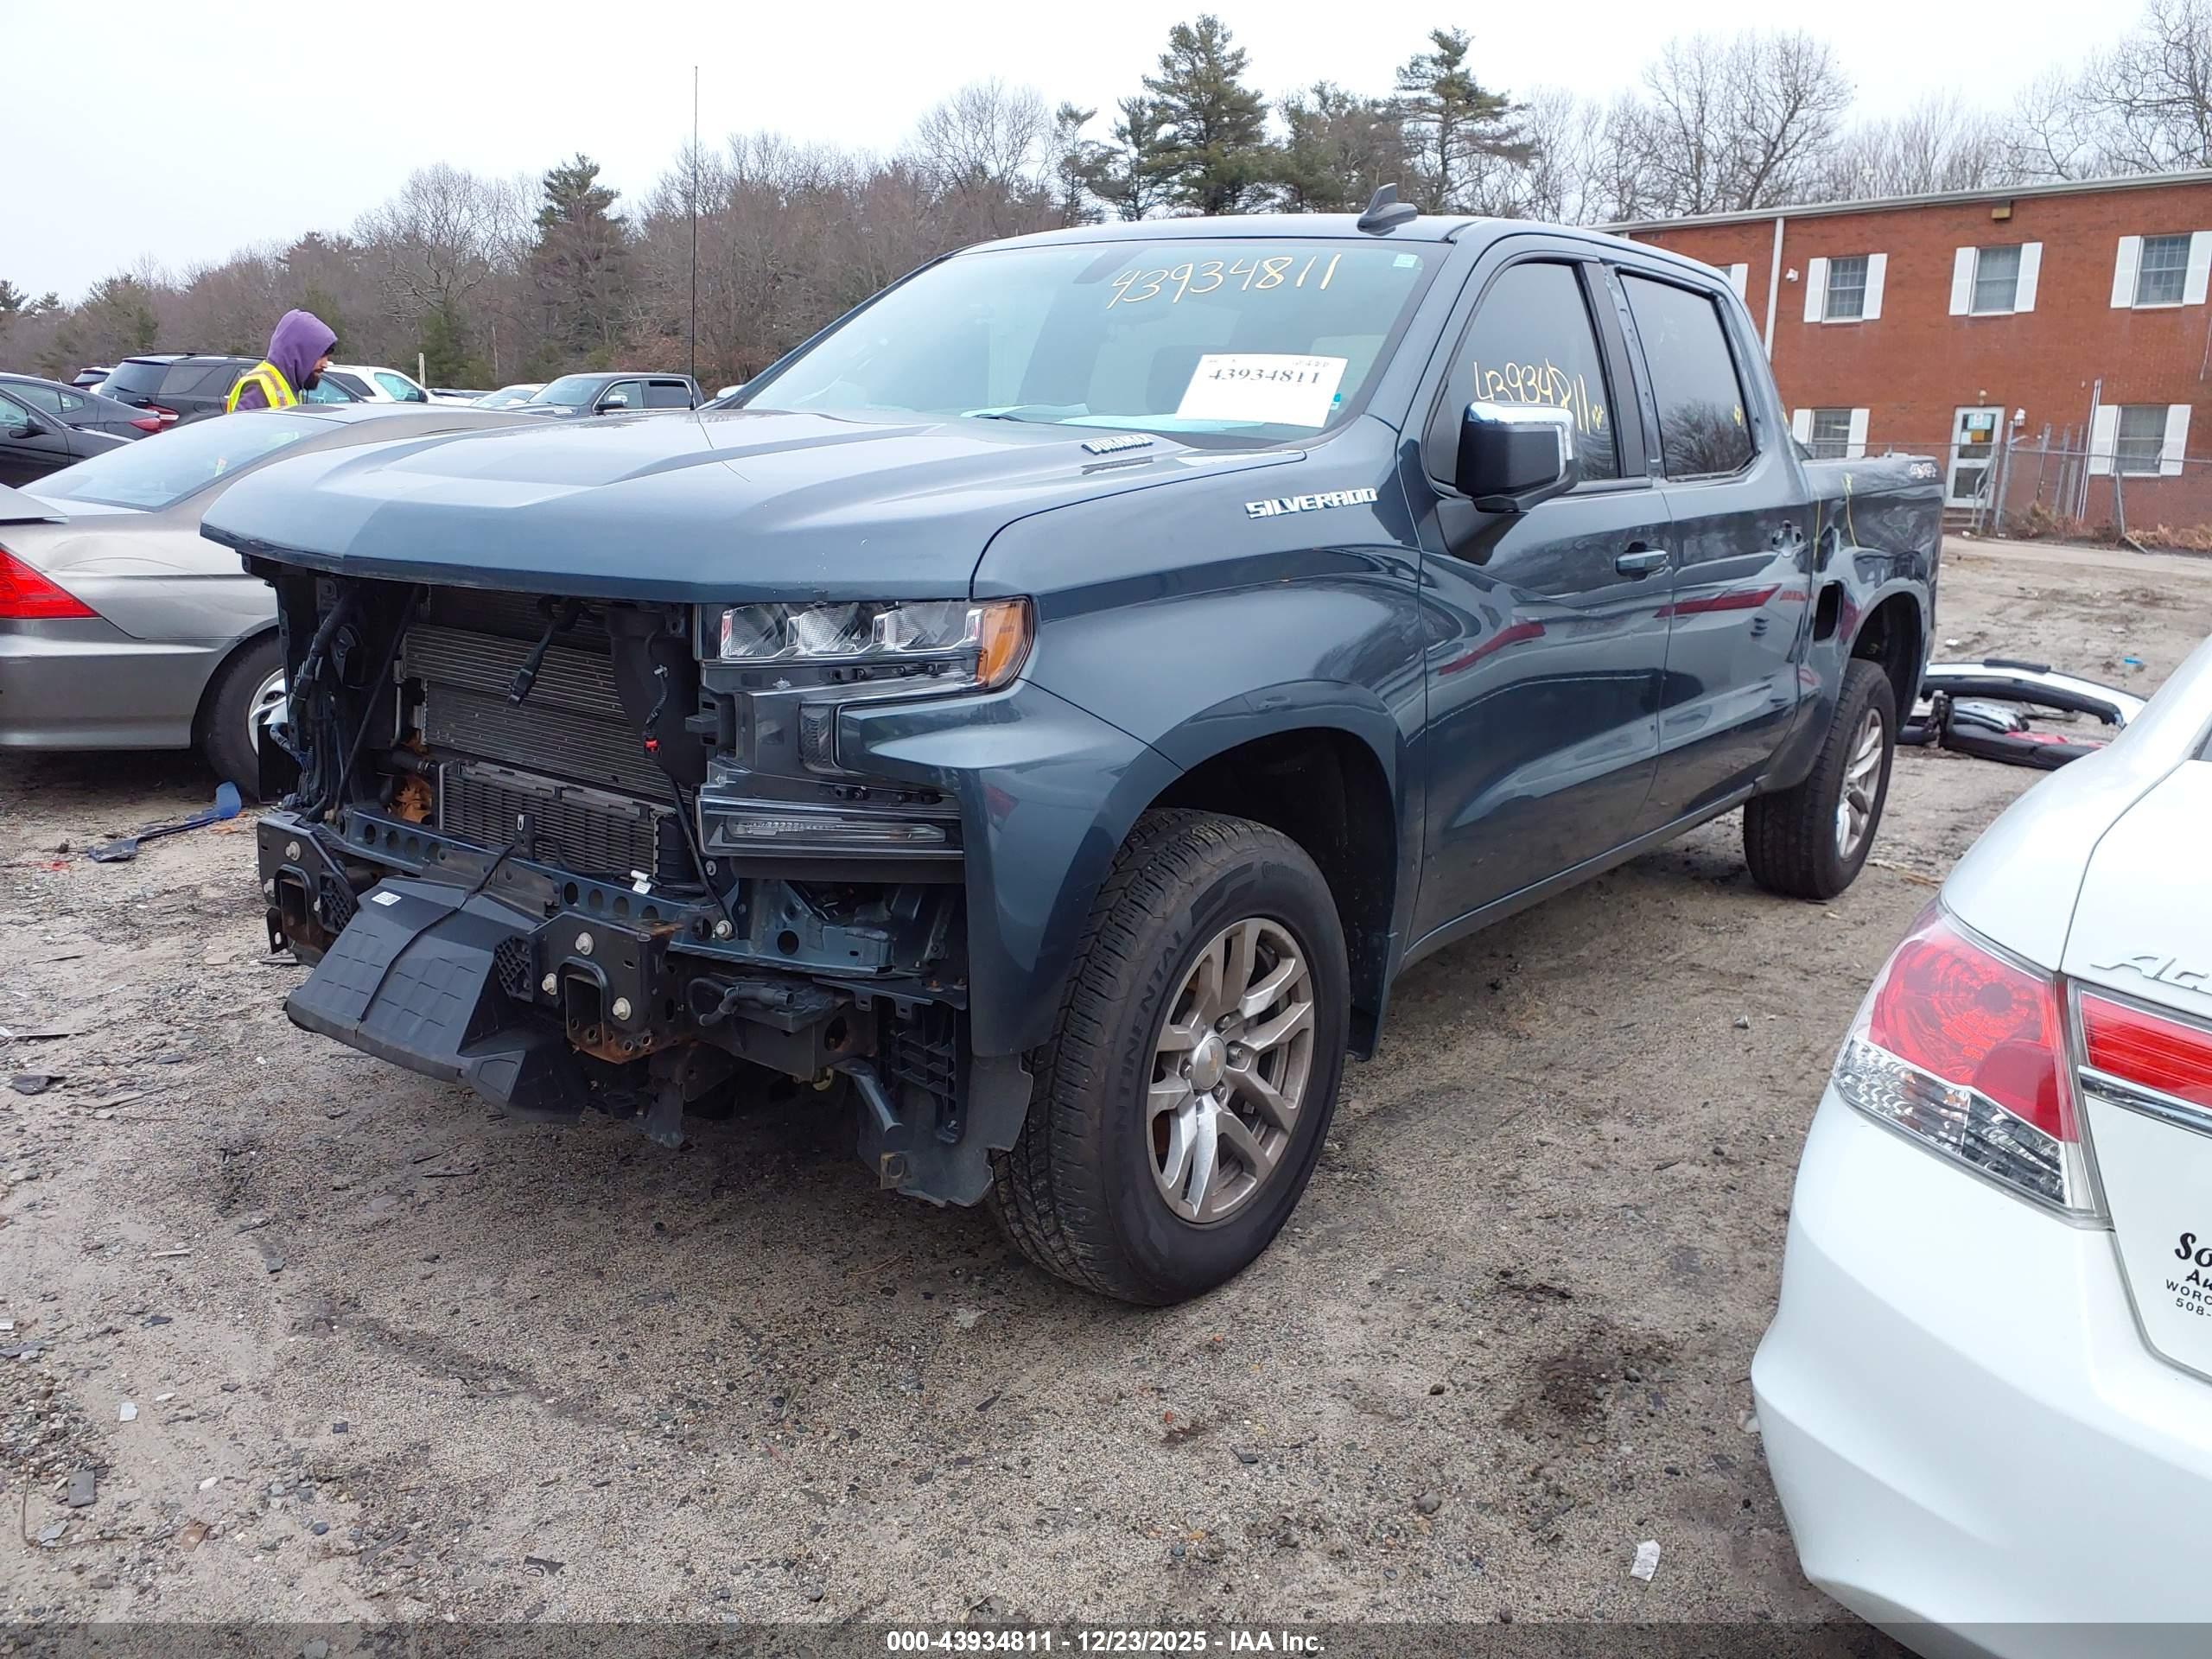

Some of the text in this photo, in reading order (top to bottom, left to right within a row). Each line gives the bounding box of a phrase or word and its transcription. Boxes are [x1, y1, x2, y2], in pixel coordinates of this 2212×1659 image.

[1106, 253, 1342, 309] 43934811
[1208, 368, 1320, 385] 43934811
[1244, 487, 1378, 519] SILVERADO
[2165, 1279, 2212, 1306] WORC
[2176, 1297, 2212, 1317] 508-
